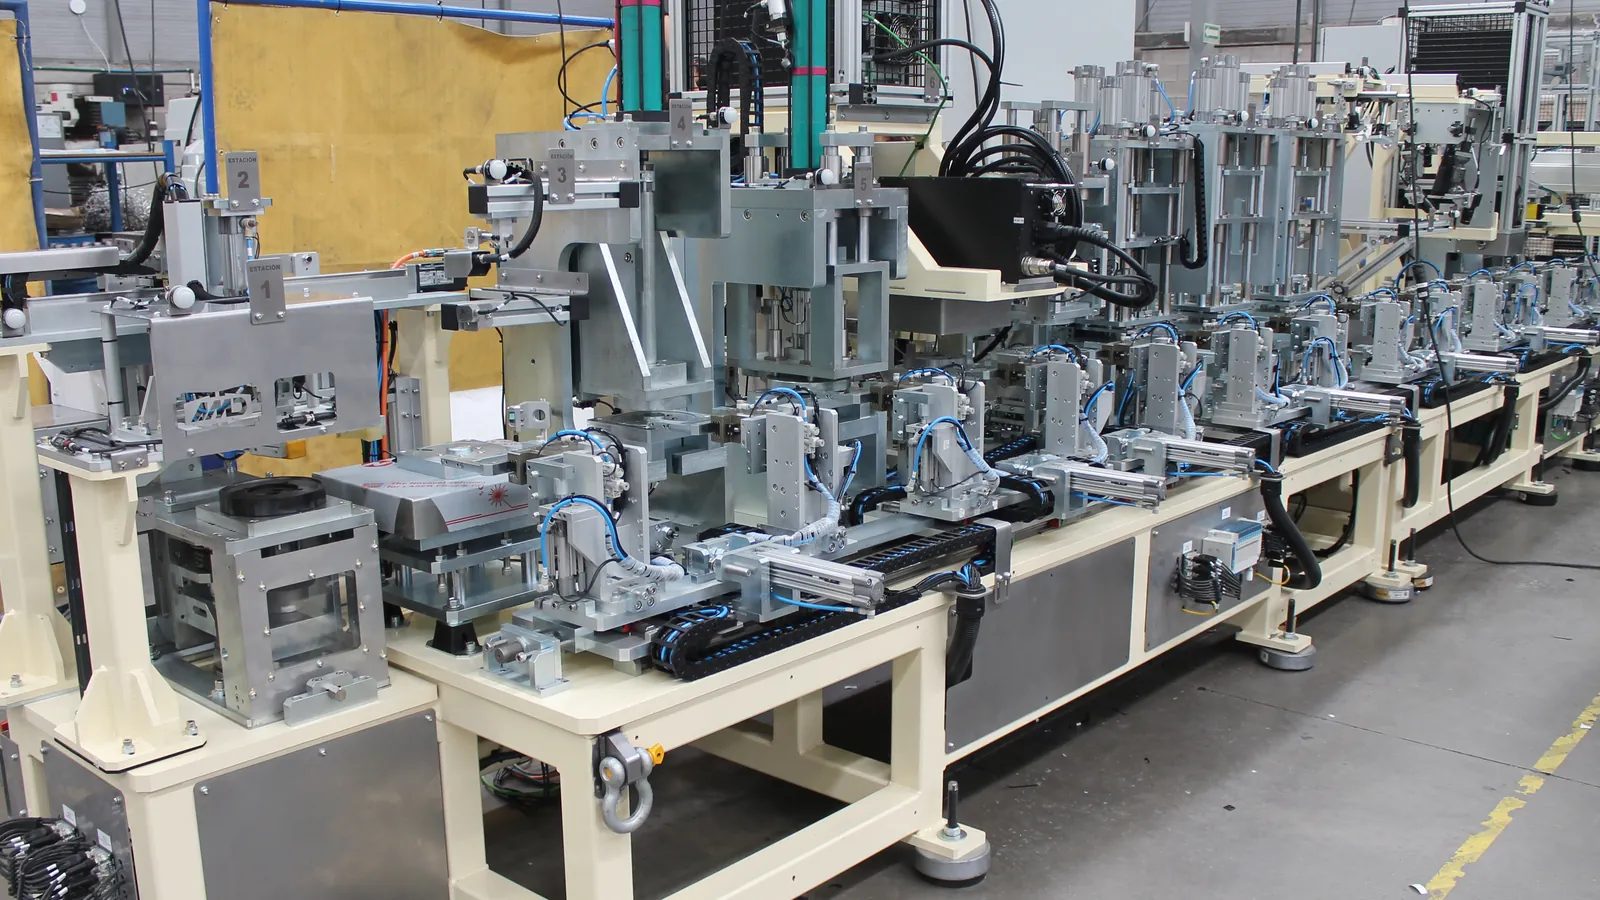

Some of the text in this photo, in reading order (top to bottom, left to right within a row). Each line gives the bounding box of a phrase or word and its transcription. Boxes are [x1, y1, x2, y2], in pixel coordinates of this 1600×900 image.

[677, 115, 686, 131] 4
[237, 171, 249, 188] 2
[557, 166, 567, 183] 3
[860, 177, 867, 191] 5
[260, 280, 271, 299] 1
